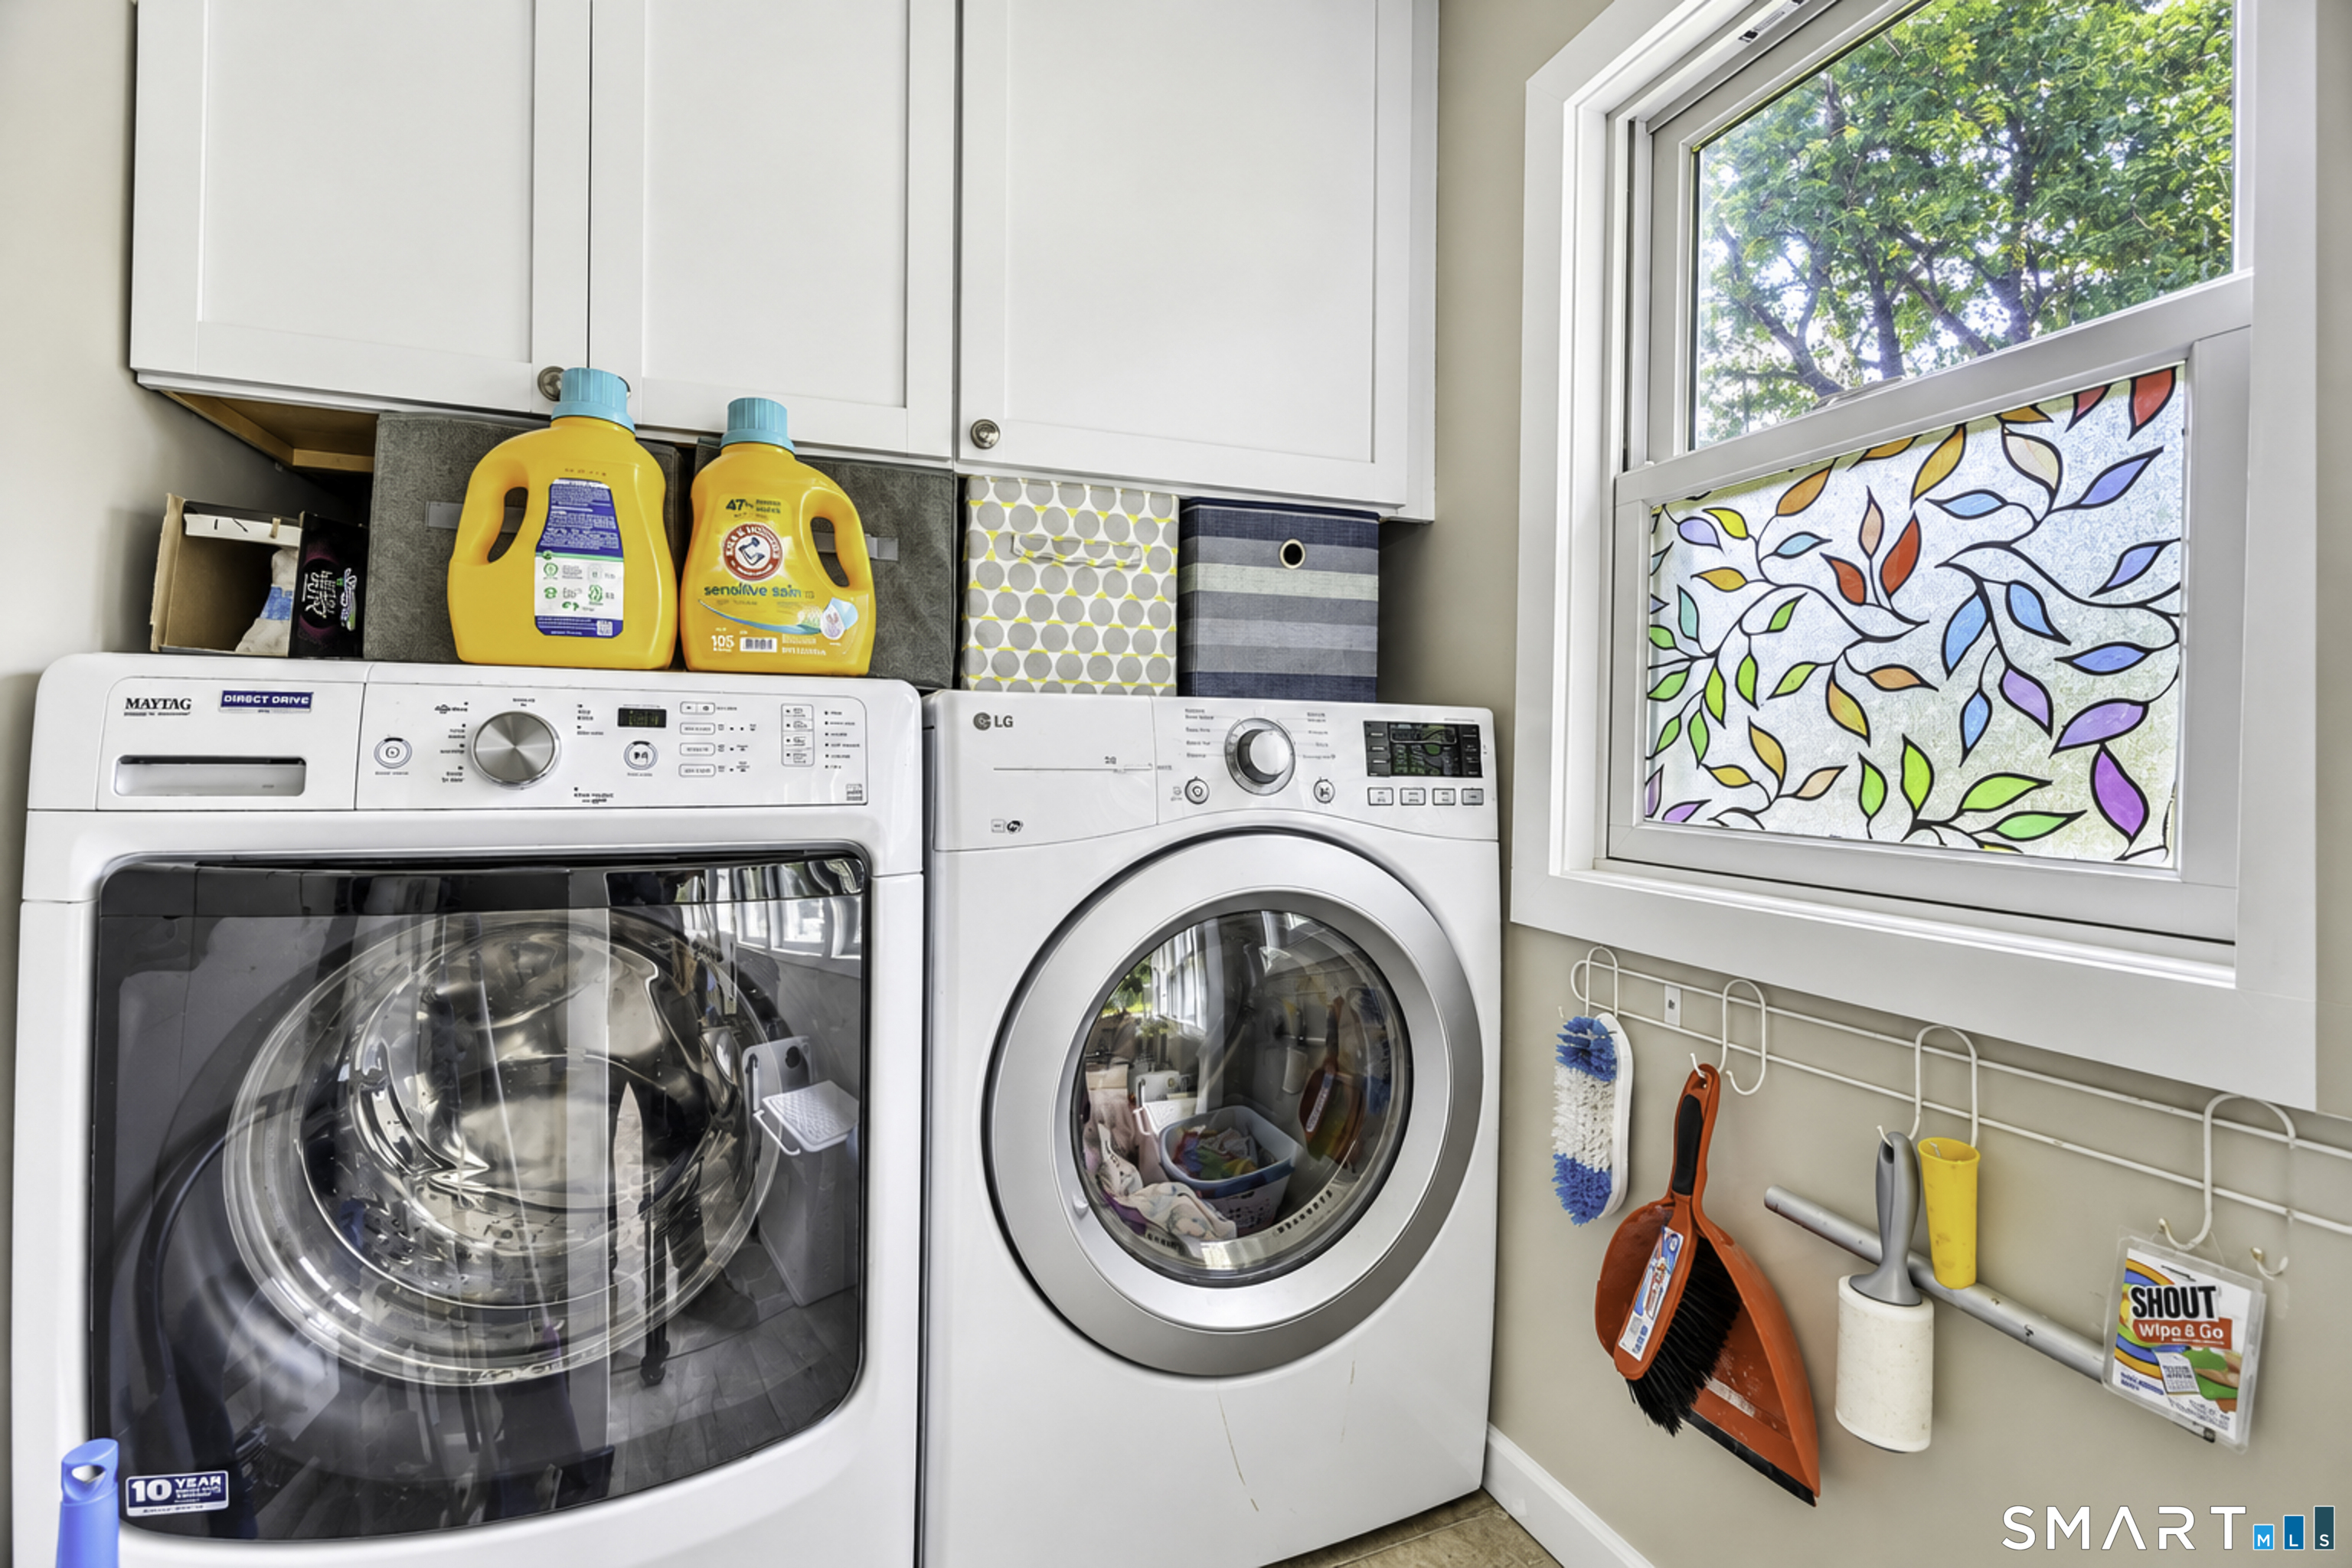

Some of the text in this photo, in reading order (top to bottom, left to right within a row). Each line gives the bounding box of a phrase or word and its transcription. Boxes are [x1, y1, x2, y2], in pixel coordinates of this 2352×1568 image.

[125, 697, 191, 710] MAYTAG
[995, 715, 1014, 728] LG
[2131, 1285, 2216, 1318] SHOUT
[2200, 1324, 2223, 1339] Go
[131, 1478, 172, 1502] 10
